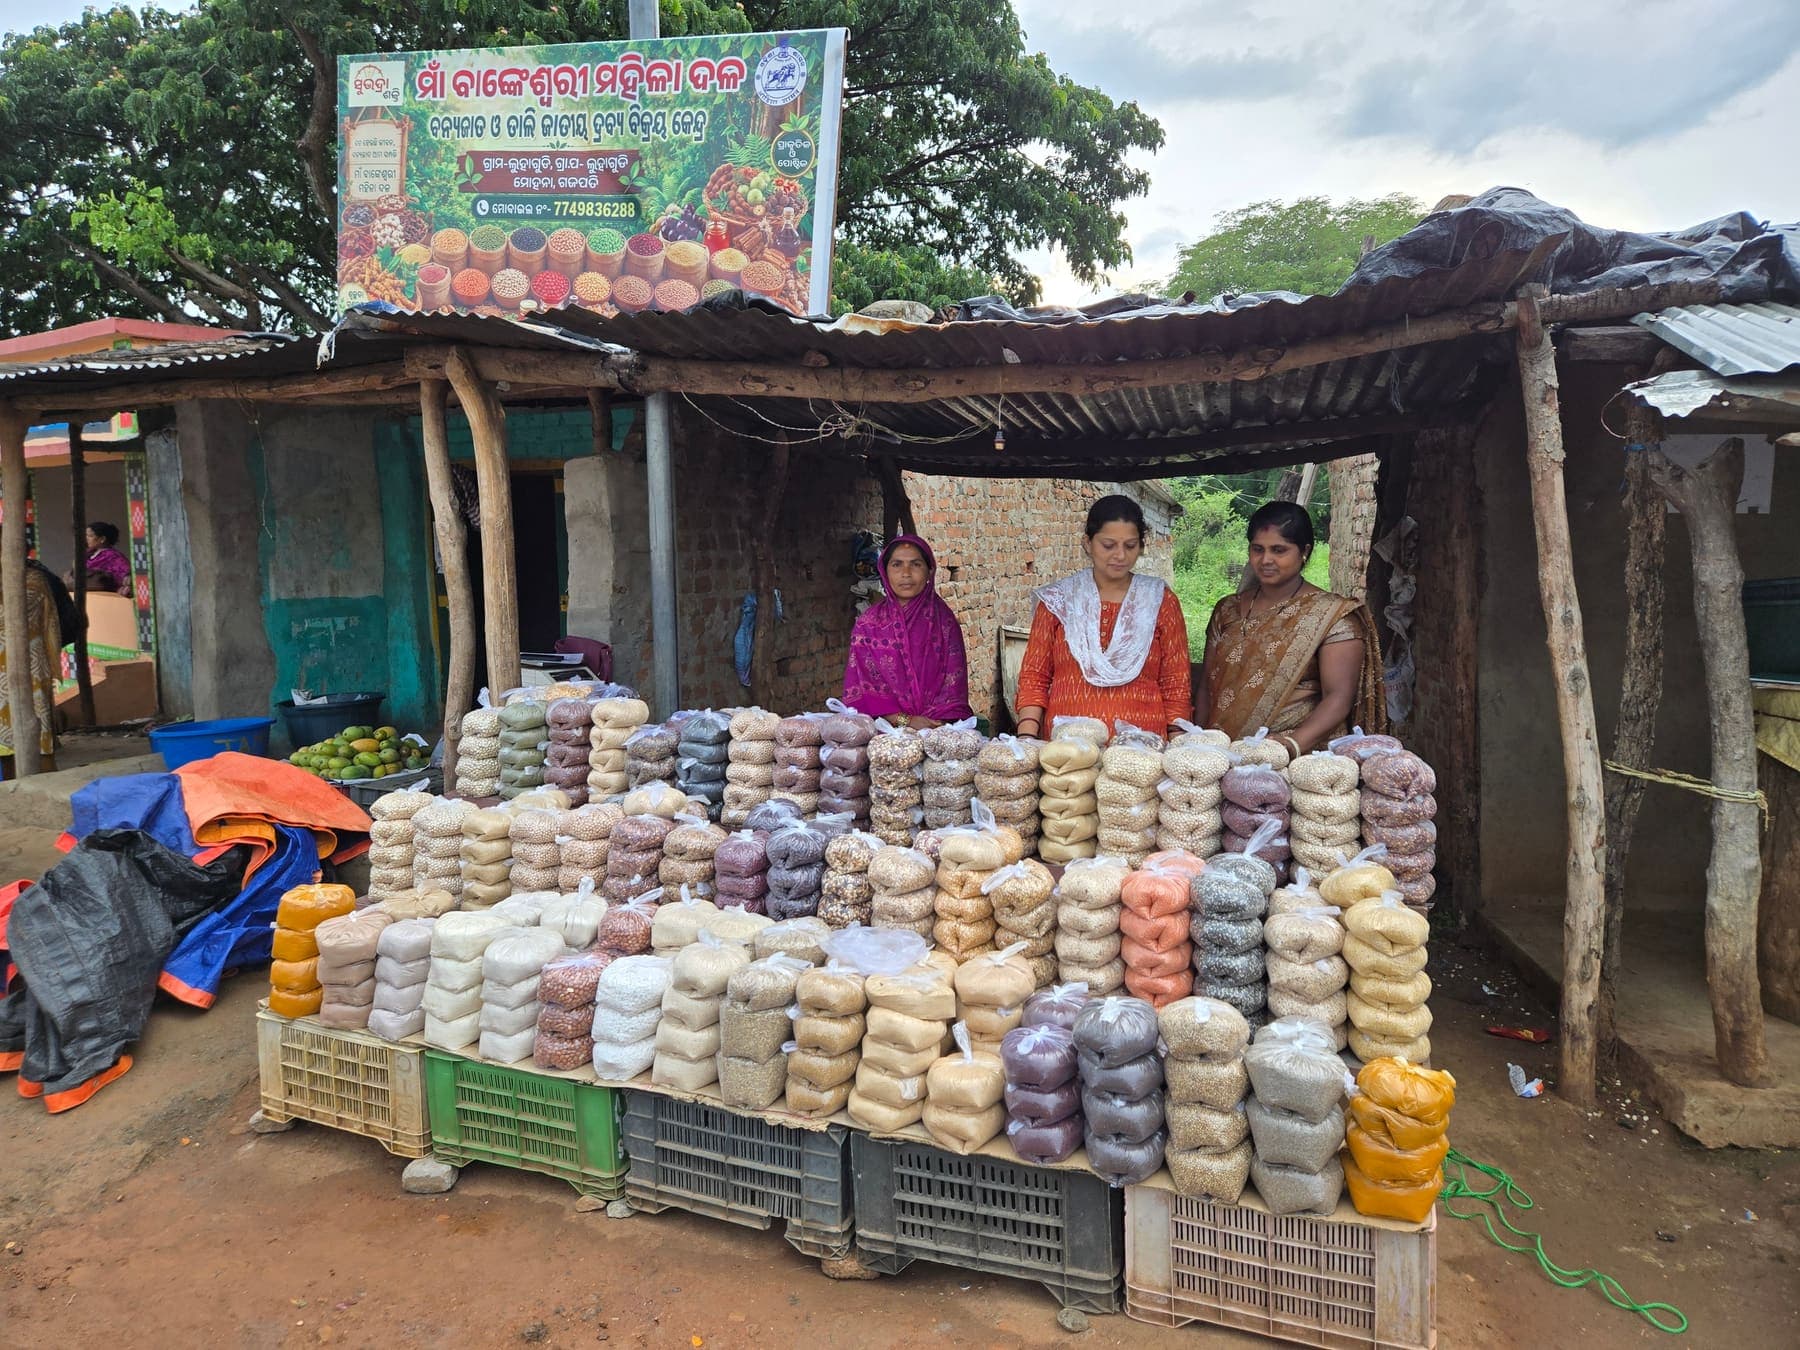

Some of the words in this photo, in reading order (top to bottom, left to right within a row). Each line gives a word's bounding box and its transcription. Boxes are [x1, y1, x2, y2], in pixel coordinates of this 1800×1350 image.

[595, 54, 682, 100] ମହିଳା
[689, 59, 745, 91] ଦଳ
[430, 115, 486, 138] ବନ୍ୟଜାତ
[491, 114, 501, 138] ଓ
[554, 201, 636, 217] 7749836288
